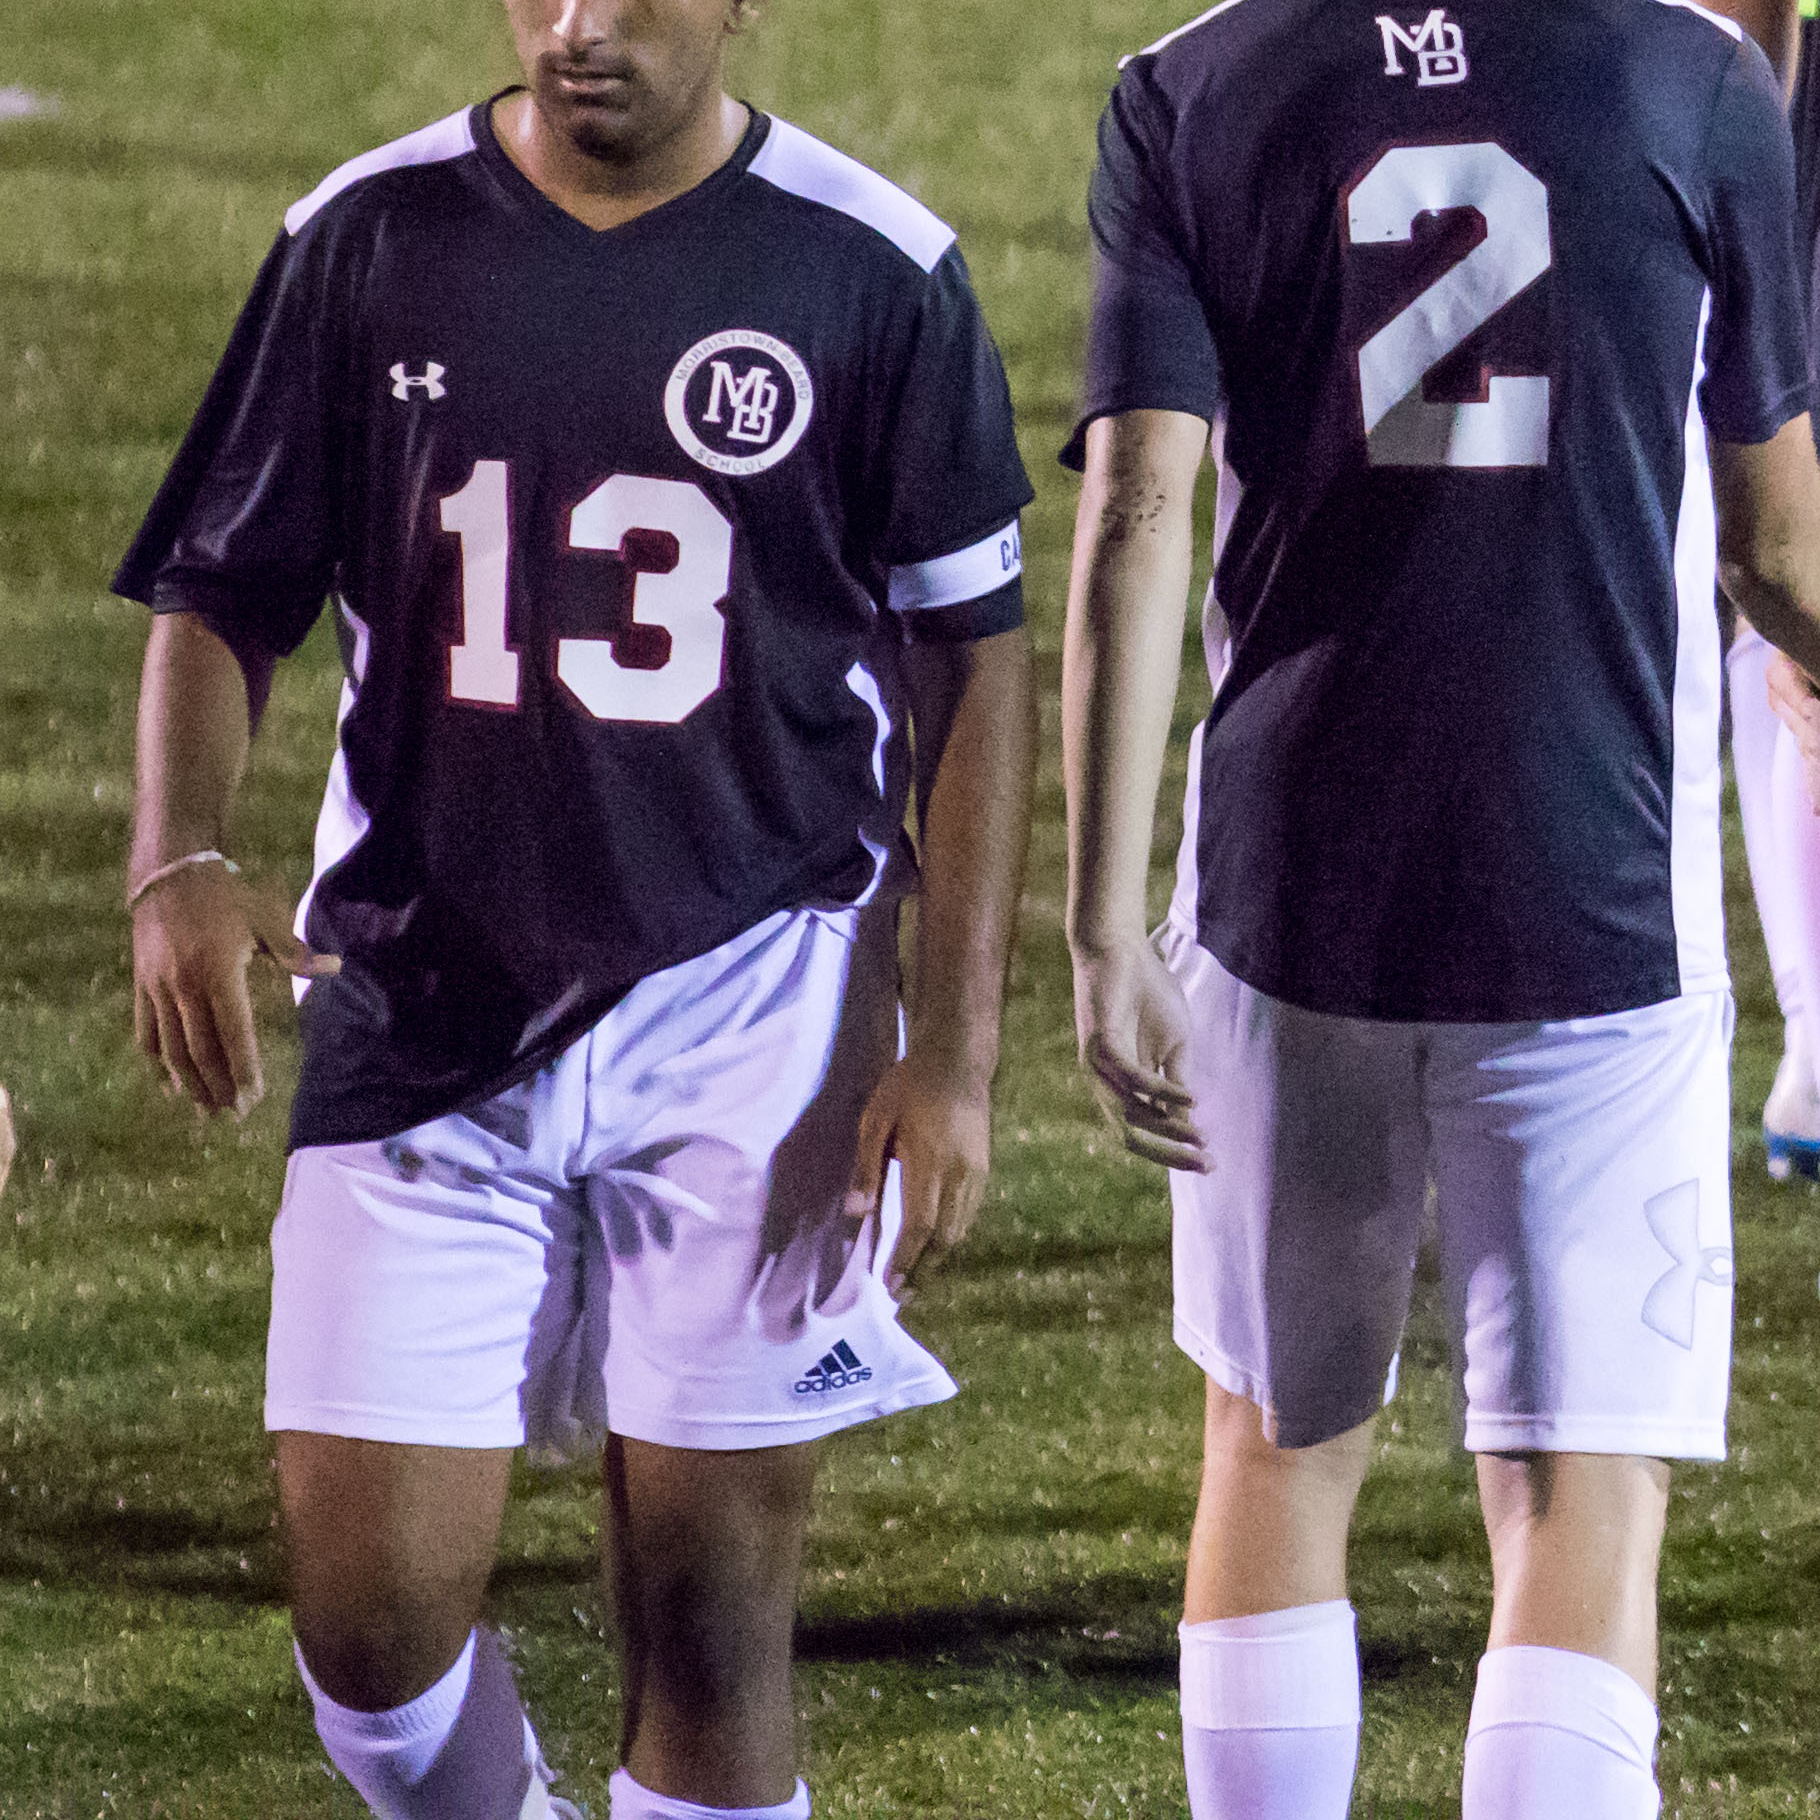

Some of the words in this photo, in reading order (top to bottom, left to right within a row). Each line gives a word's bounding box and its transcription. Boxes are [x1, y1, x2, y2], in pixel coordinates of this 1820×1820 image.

[1347, 141, 1552, 468] 2
[694, 447, 766, 475] SCHOOL
[439, 459, 734, 725] 13
[794, 1366, 873, 1394] adidas
